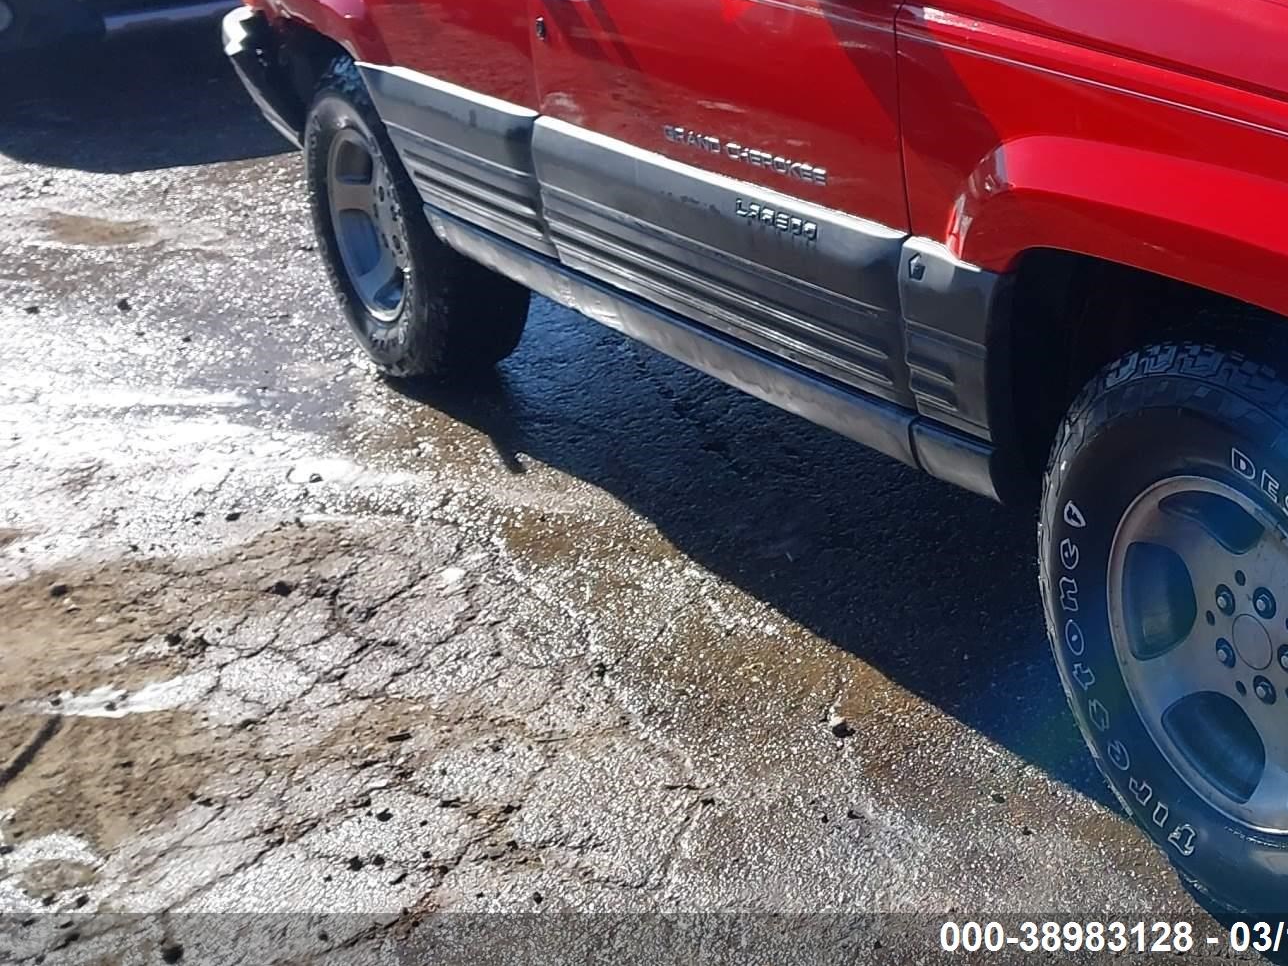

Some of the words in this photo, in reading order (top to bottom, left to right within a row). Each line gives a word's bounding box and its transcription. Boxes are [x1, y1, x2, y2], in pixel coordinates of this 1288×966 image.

[664, 124, 721, 153] GRAND
[725, 142, 828, 186] CHEROKEE
[735, 198, 818, 241] LAREDO
